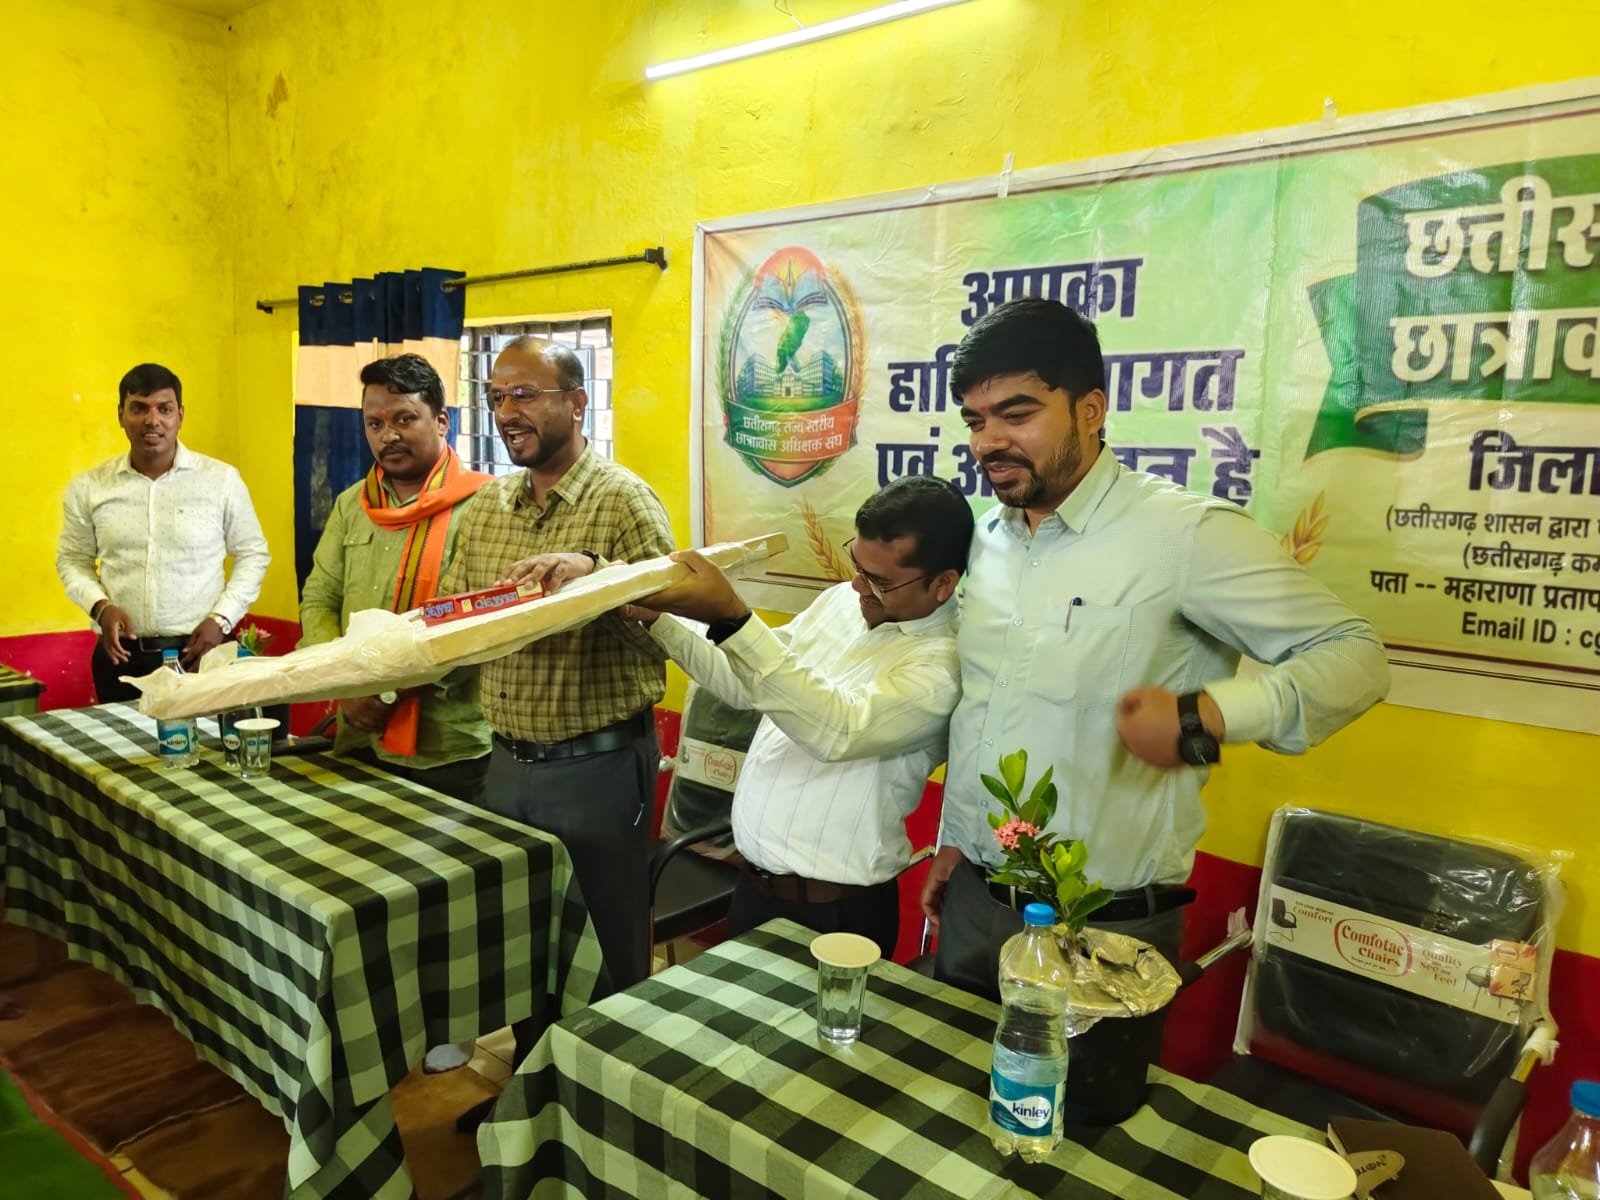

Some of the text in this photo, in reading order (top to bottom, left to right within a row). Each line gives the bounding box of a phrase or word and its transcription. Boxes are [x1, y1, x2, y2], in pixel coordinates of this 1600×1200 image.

[1202, 427, 1261, 506] है
[1484, 513, 1542, 535] शासन
[1548, 516, 1590, 539] द्वारा
[1371, 570, 1408, 594] पता
[1444, 577, 1536, 606] महाराणा
[1462, 611, 1525, 641] Email
[1532, 618, 1557, 644] ID
[1358, 947, 1401, 967] Chairs
[1012, 1102, 1050, 1119] kinley
